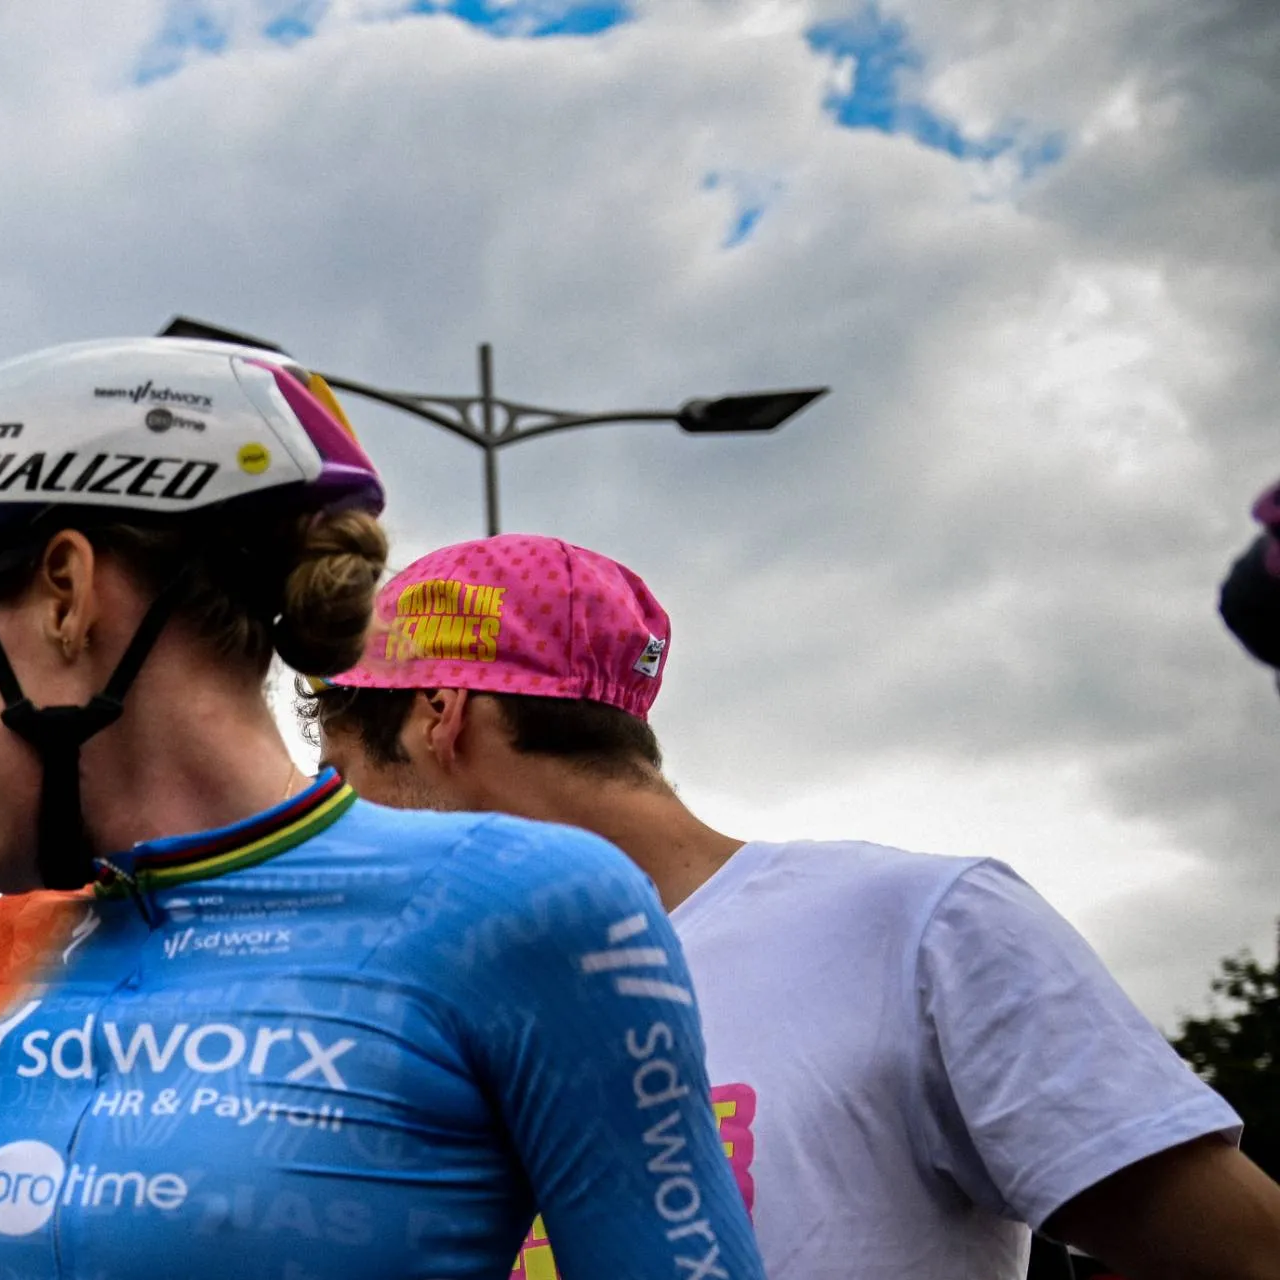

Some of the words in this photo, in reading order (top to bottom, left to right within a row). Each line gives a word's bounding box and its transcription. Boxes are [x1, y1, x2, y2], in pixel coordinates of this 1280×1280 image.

[462, 583, 506, 618] THE
[385, 613, 502, 662] FEMMES
[15, 1014, 358, 1092] sdworx
[91, 1091, 143, 1117] HR
[150, 1088, 178, 1115] &
[189, 1088, 344, 1133] Payroll
